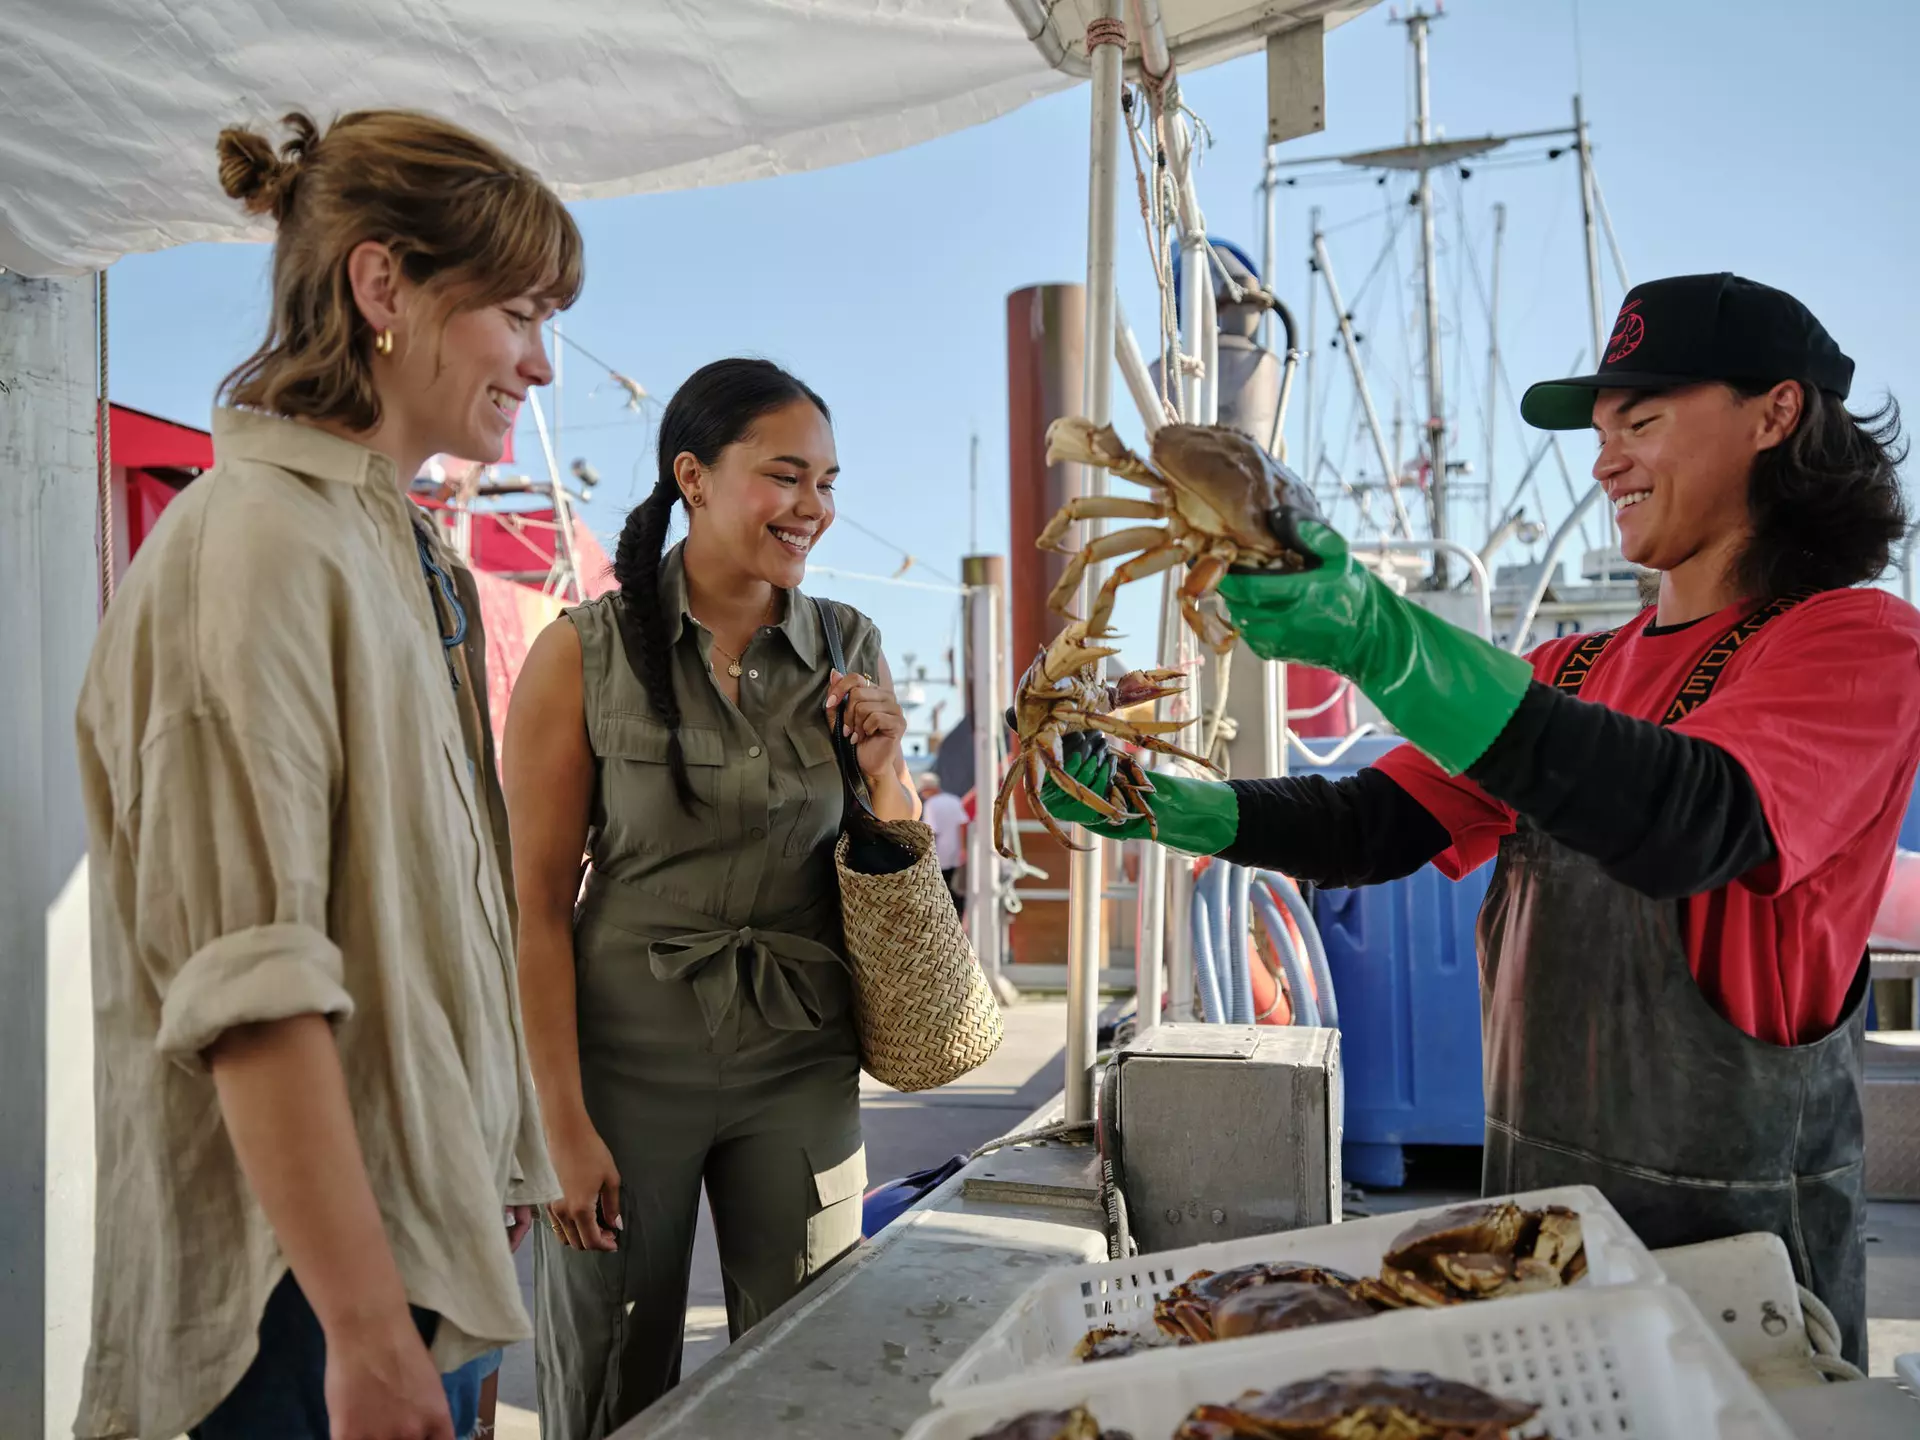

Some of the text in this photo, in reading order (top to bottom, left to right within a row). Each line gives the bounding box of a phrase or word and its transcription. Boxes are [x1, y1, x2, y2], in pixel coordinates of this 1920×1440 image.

[1104, 1160, 1114, 1181] ITALY
[1107, 1182, 1115, 1194] IN
[1108, 1195, 1117, 1223] MADE
